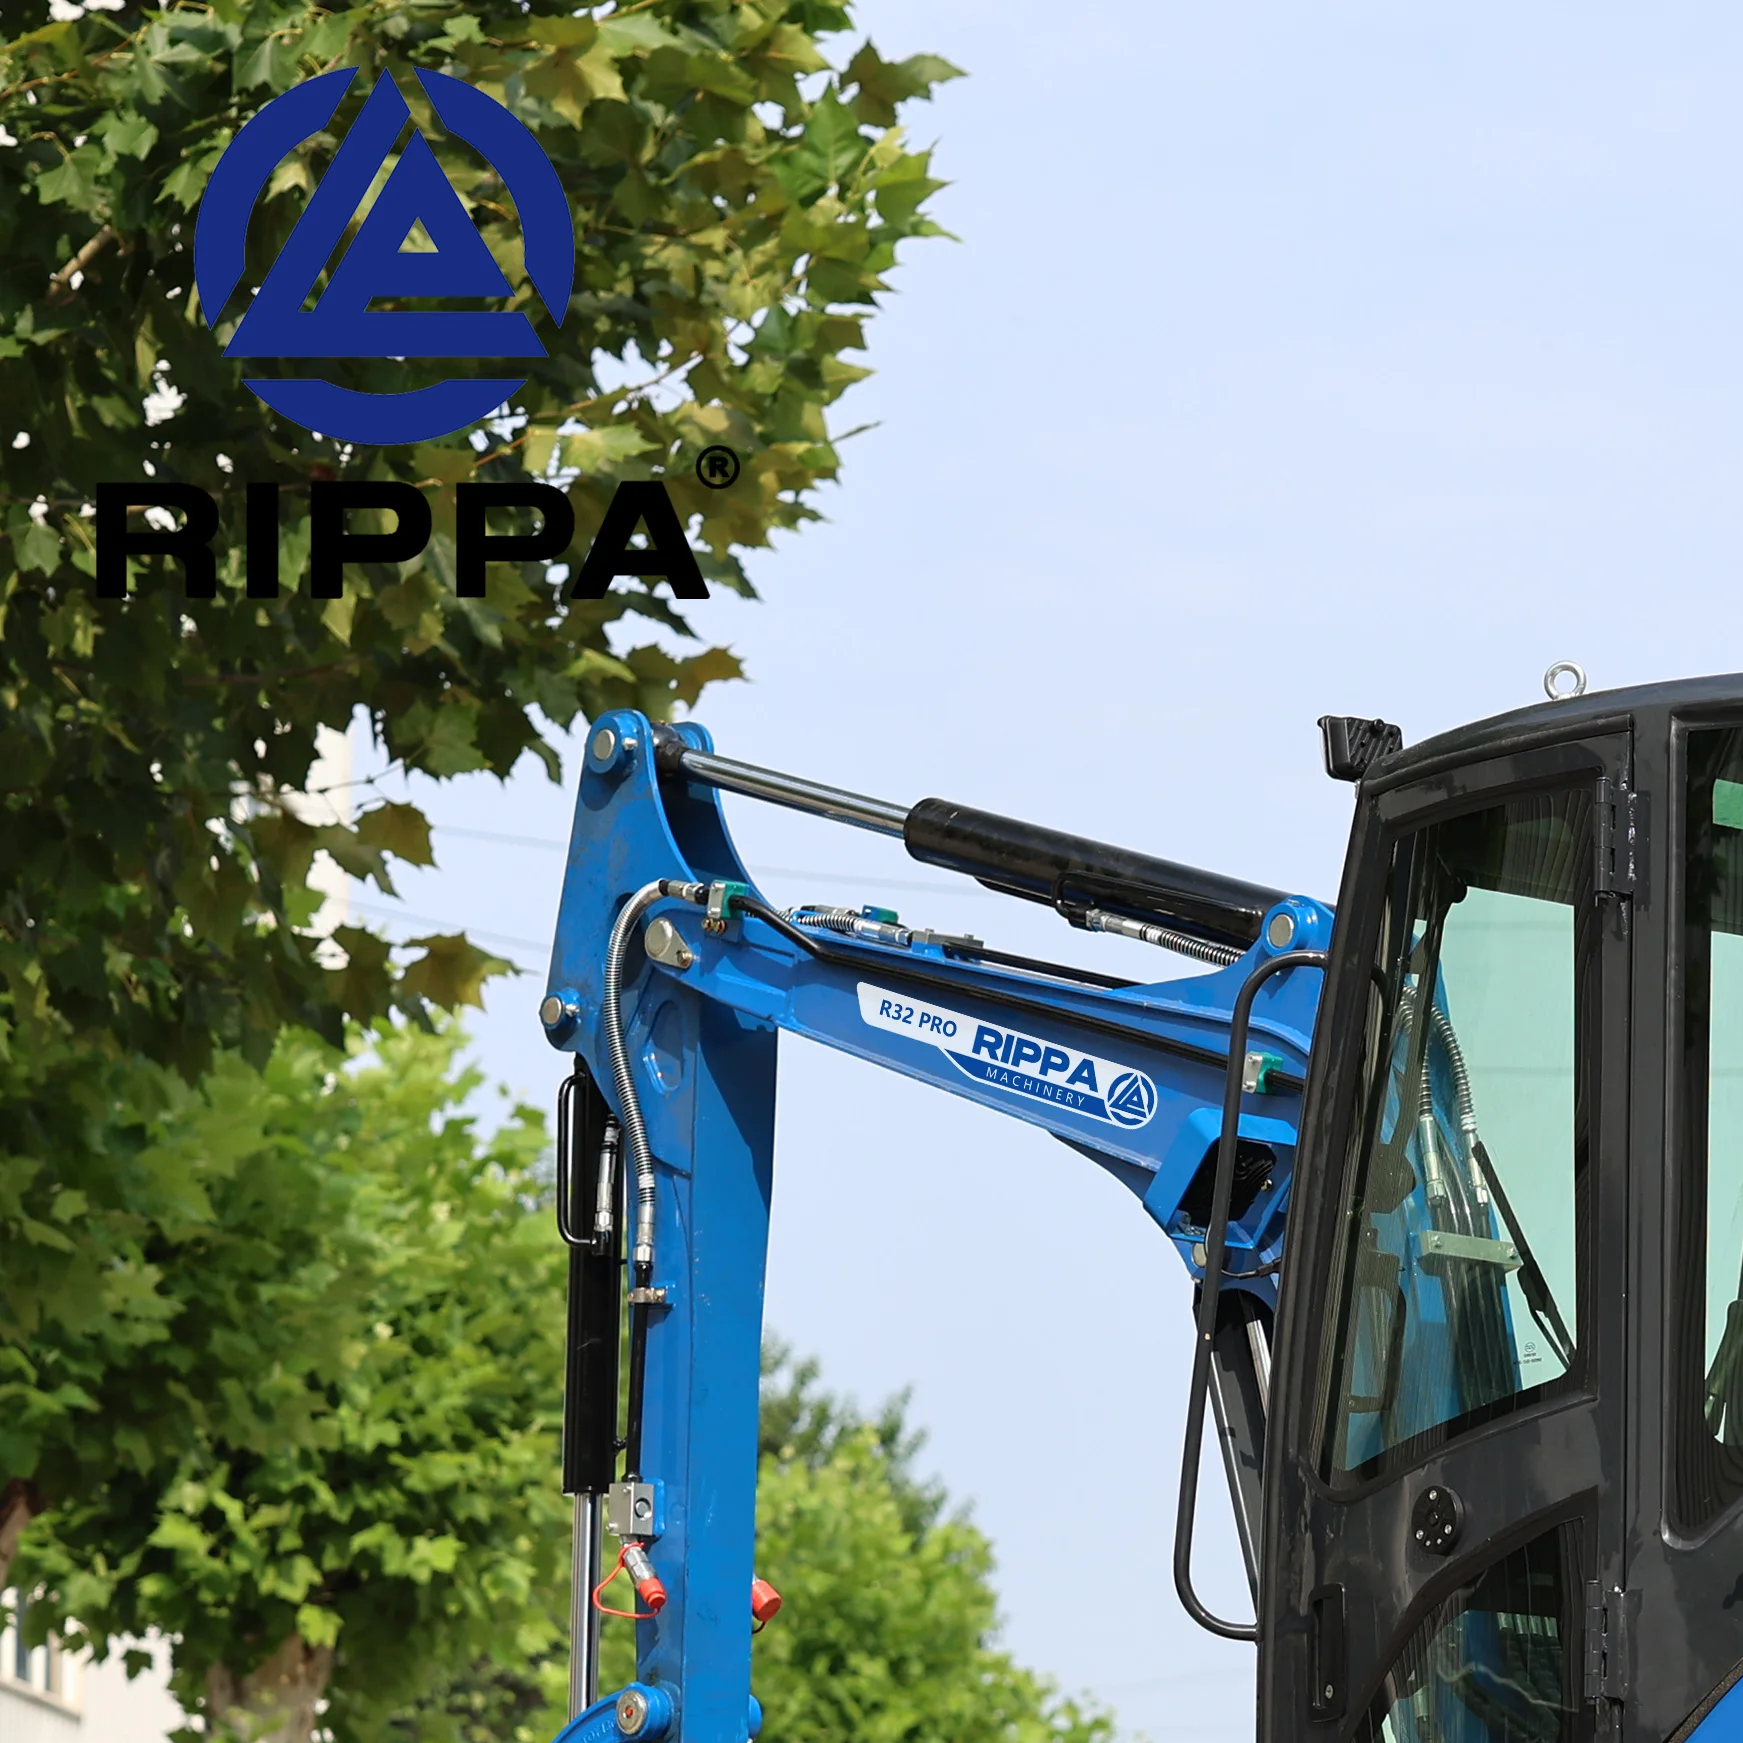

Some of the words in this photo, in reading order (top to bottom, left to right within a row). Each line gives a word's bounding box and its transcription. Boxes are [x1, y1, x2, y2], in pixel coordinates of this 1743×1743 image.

[878, 998, 916, 1025] R32
[918, 1010, 958, 1038] PRO
[971, 1024, 1099, 1093] RIPPA
[985, 1066, 1086, 1107] MACHINERY
